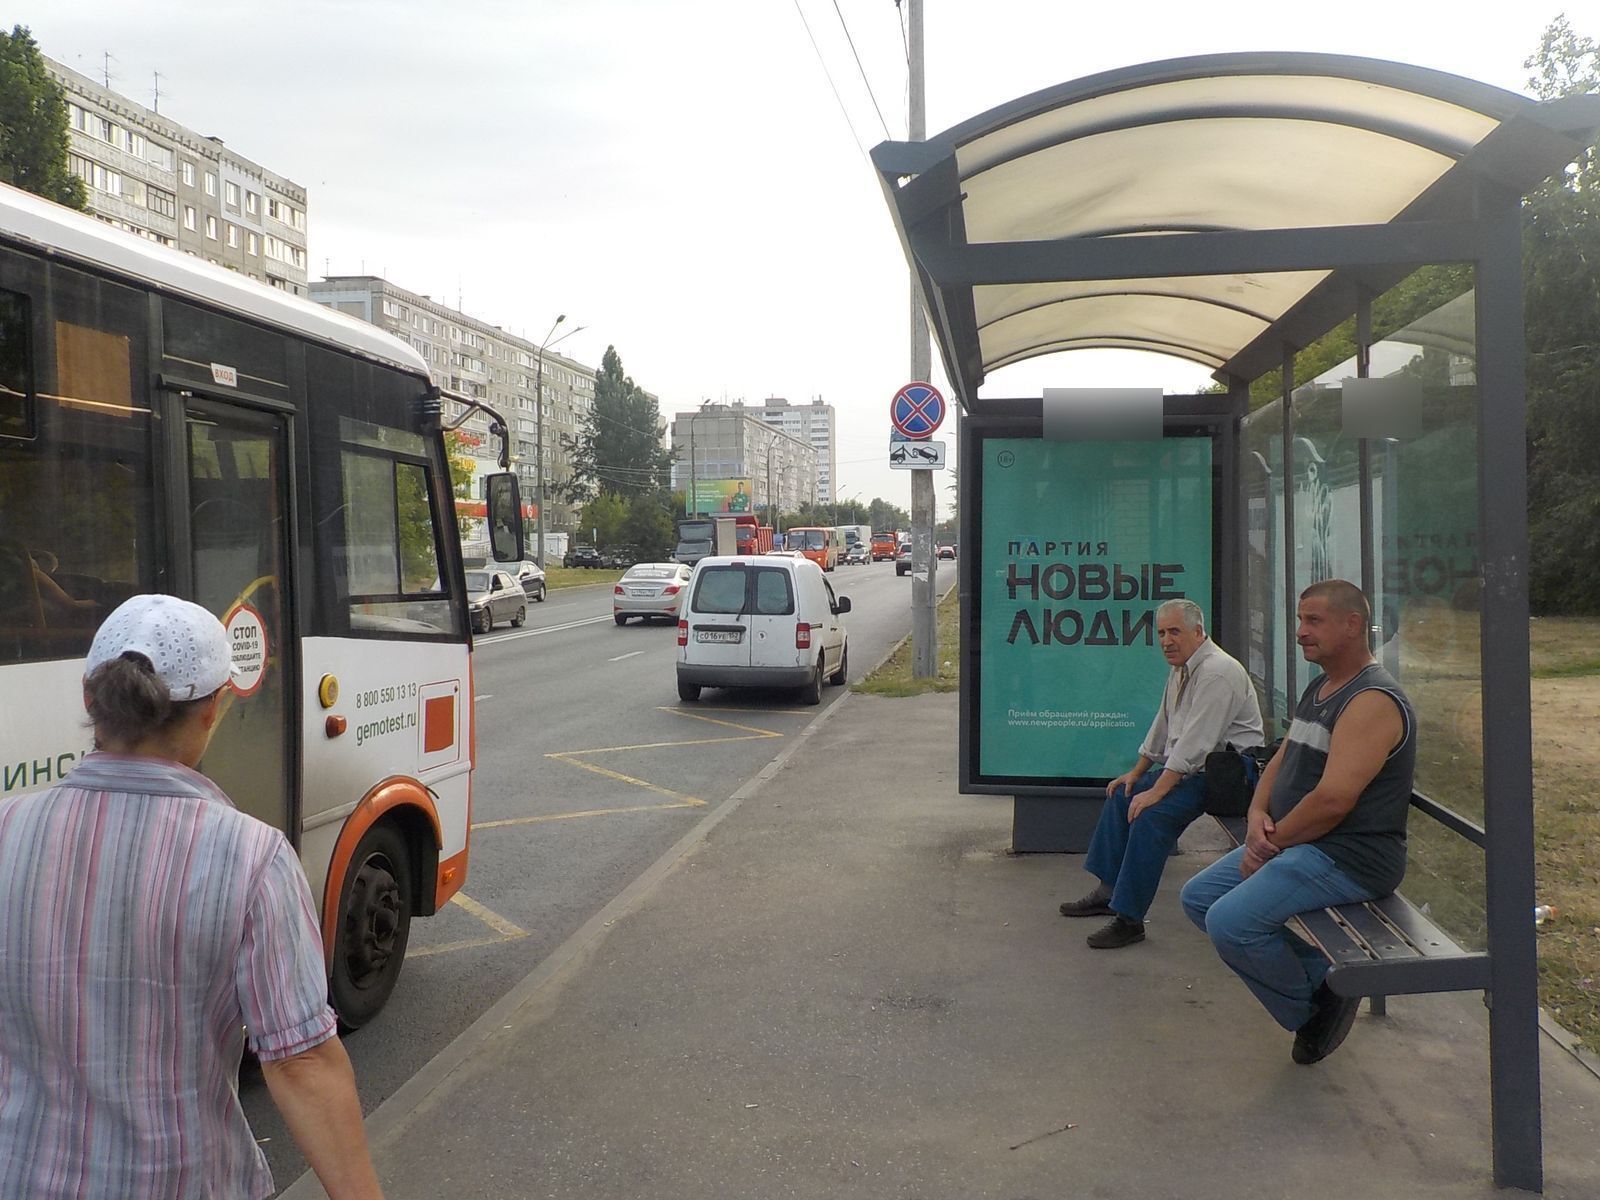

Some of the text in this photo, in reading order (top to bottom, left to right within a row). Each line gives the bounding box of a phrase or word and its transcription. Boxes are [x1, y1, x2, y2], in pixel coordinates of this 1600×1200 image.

[214, 368, 234, 384] ВХОД
[1008, 541, 1109, 556] ПАРТИЯ
[1006, 563, 1186, 601] НОВЫЕ
[233, 625, 257, 640] СТОП
[1007, 608, 1154, 647] ЛЮДИ
[232, 641, 258, 651] COVID-19
[356, 682, 417, 709] 8 800 550 13 13
[1008, 709, 1038, 719] Приём
[1038, 709, 1090, 719] обращений
[356, 711, 417, 747] gemotest.ru
[1008, 719, 1136, 728] www.newpeople.ru/application
